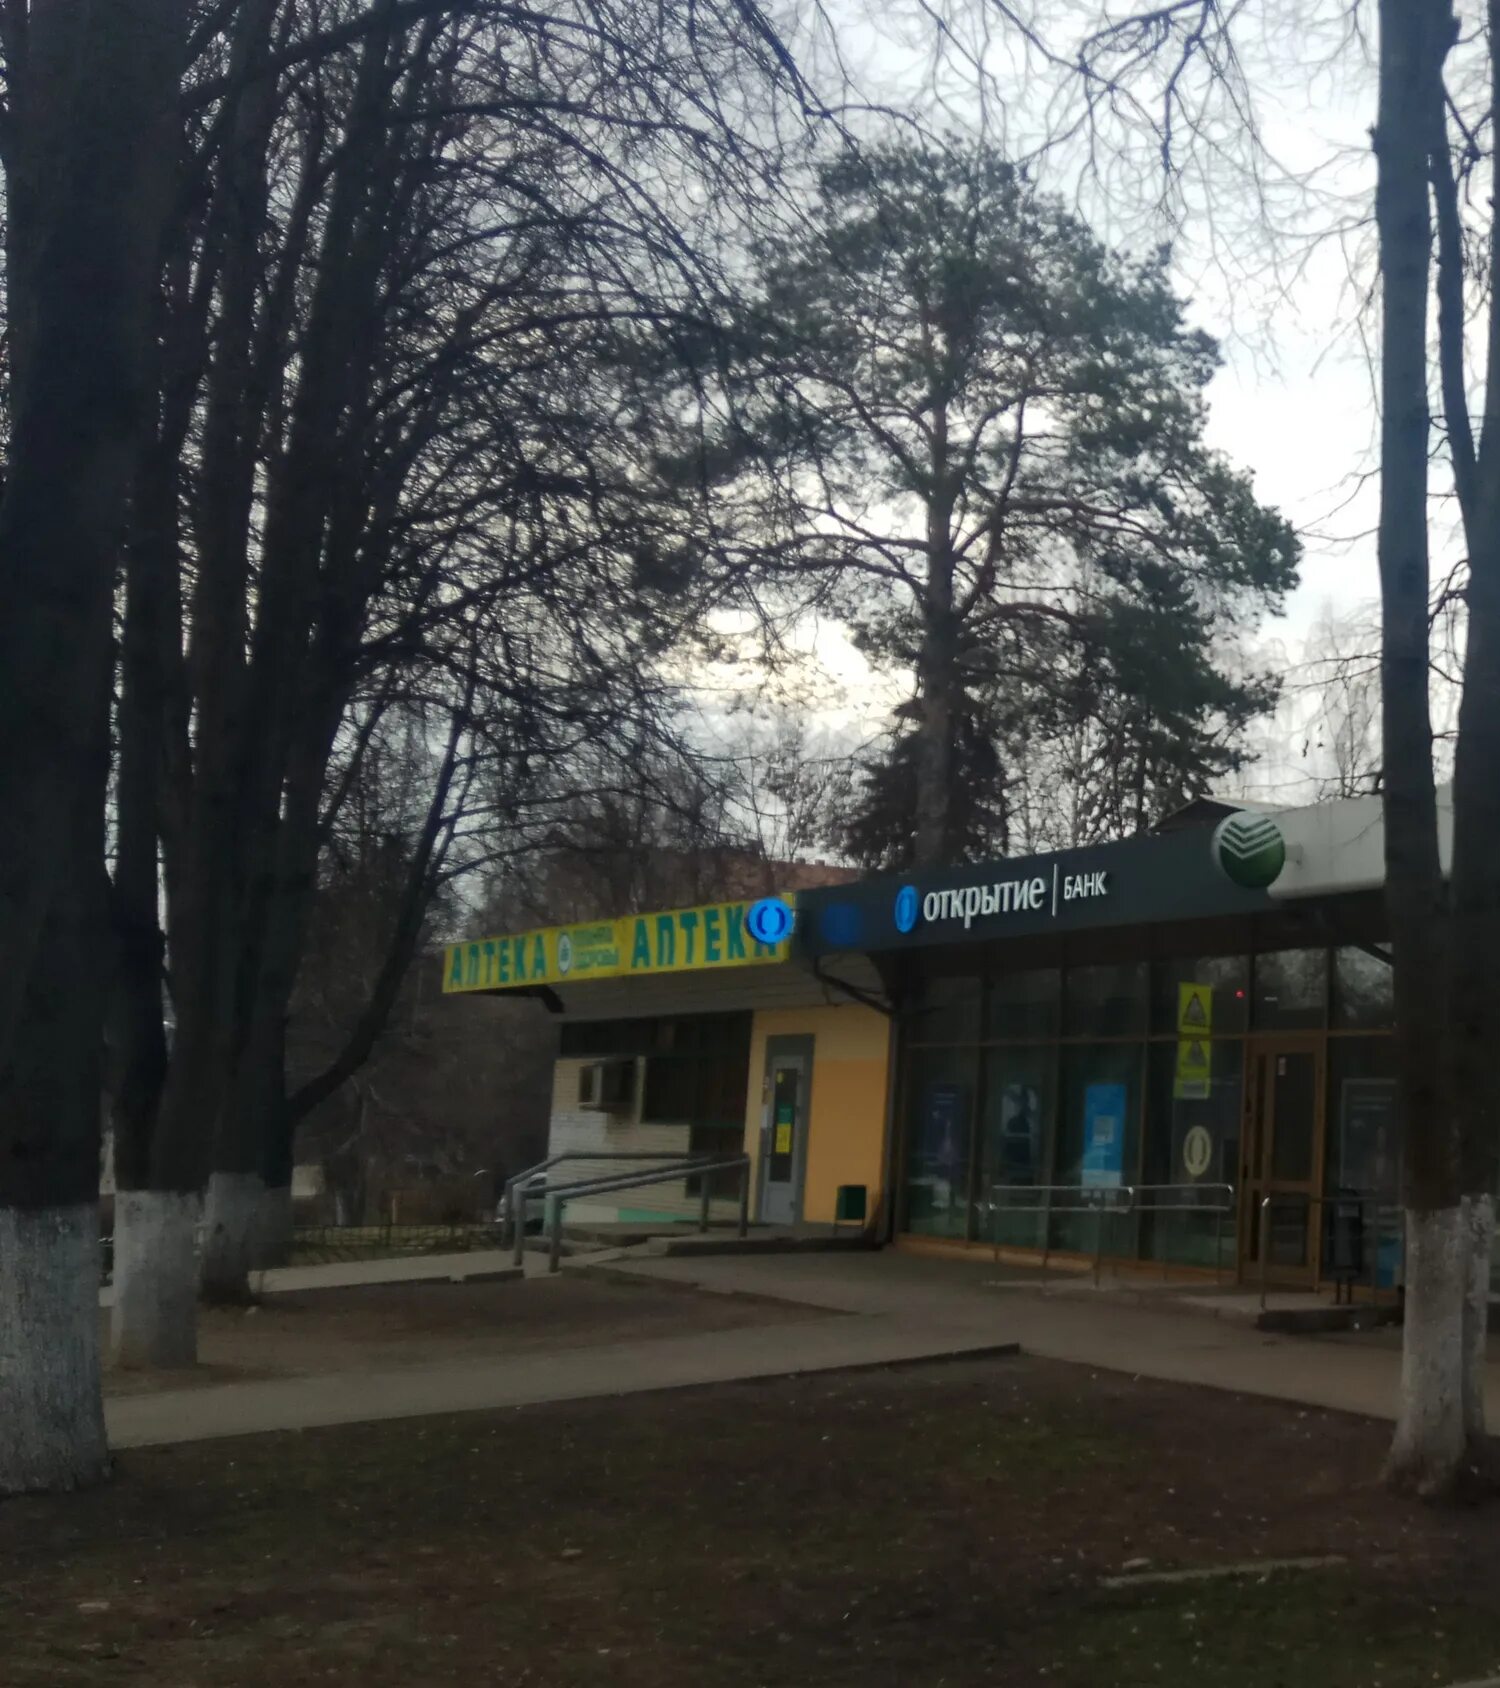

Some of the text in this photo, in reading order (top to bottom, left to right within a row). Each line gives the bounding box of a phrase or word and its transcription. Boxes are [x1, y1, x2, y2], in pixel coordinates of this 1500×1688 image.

[923, 871, 1107, 929] открытие БАНК
[451, 934, 547, 987] АПТЕКА
[630, 904, 777, 969] АПТЕК
